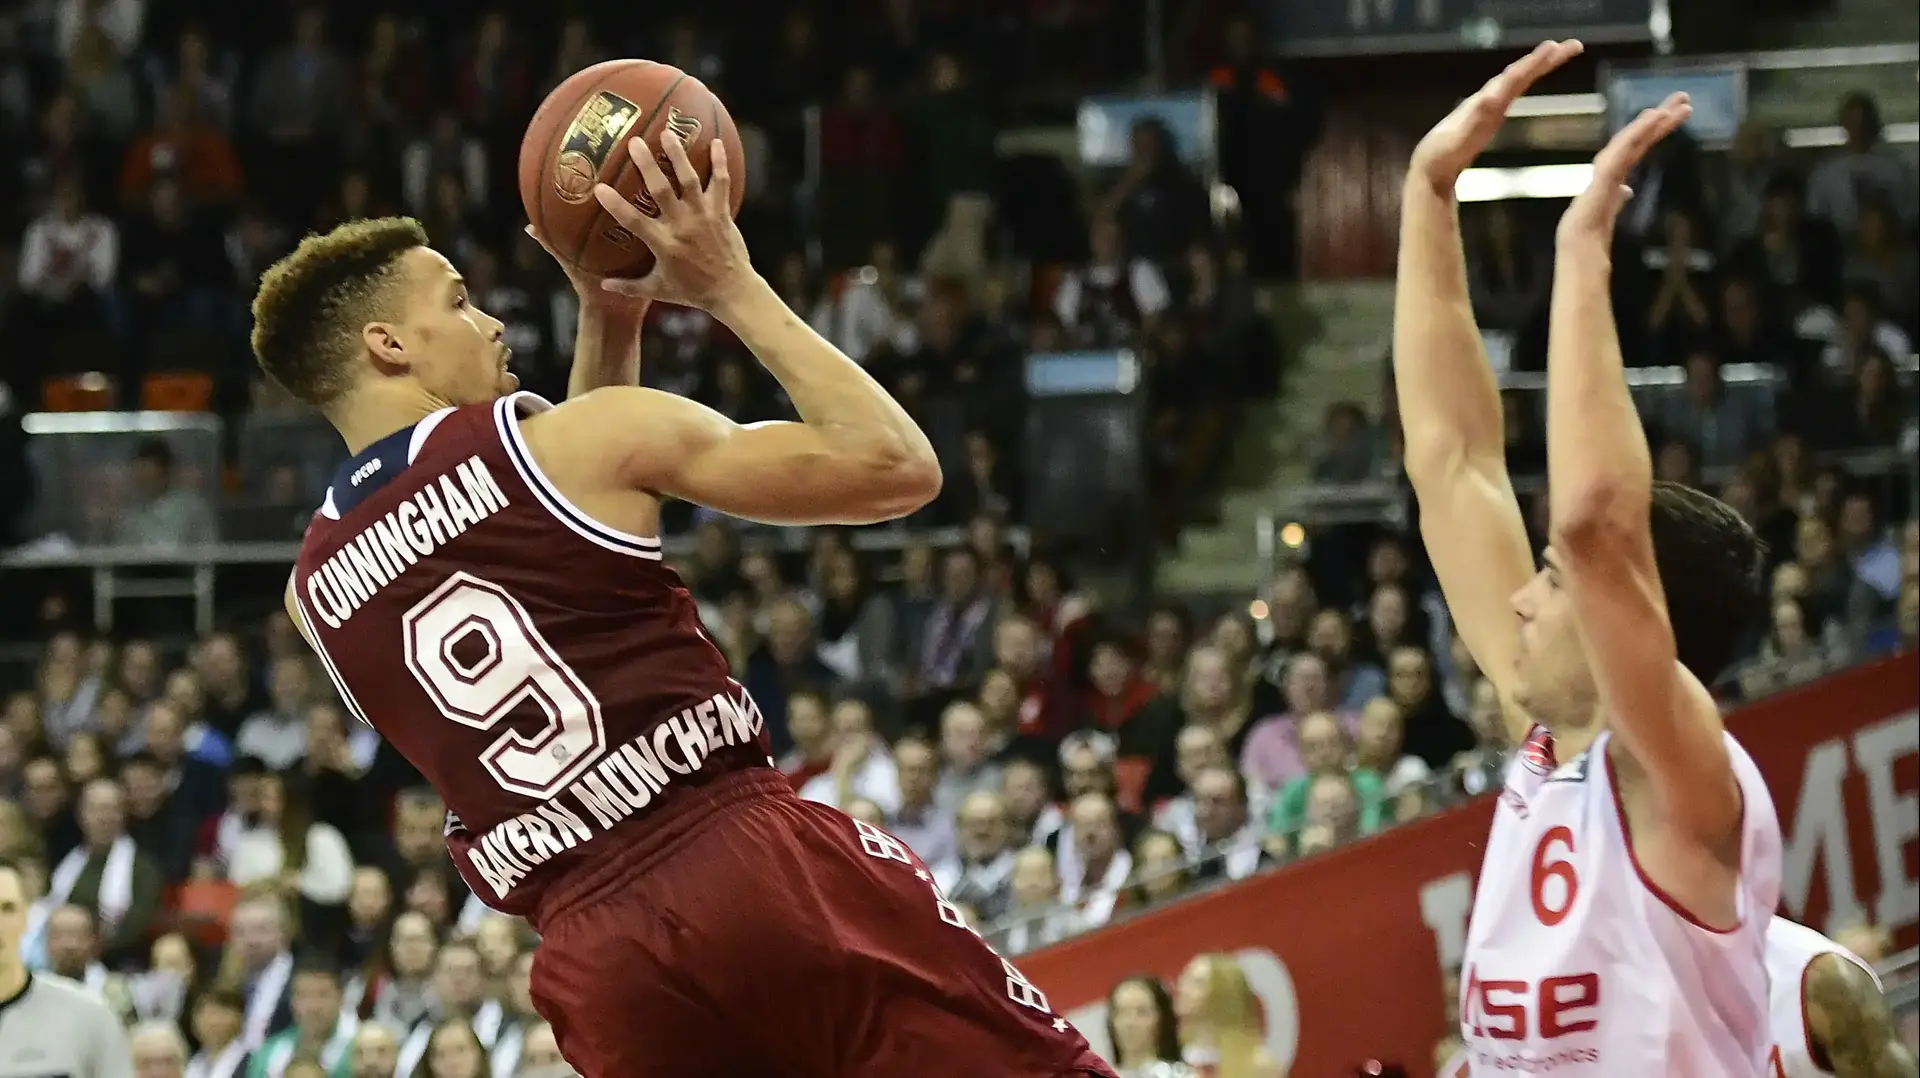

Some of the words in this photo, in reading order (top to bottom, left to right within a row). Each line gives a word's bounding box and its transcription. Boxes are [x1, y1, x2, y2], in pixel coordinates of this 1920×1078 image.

[307, 455, 510, 629] CUNNINGHAM
[402, 570, 607, 801] 9
[467, 798, 593, 900] BAYERN
[570, 691, 751, 830] MÜNCHEN
[1531, 826, 1579, 927] 6
